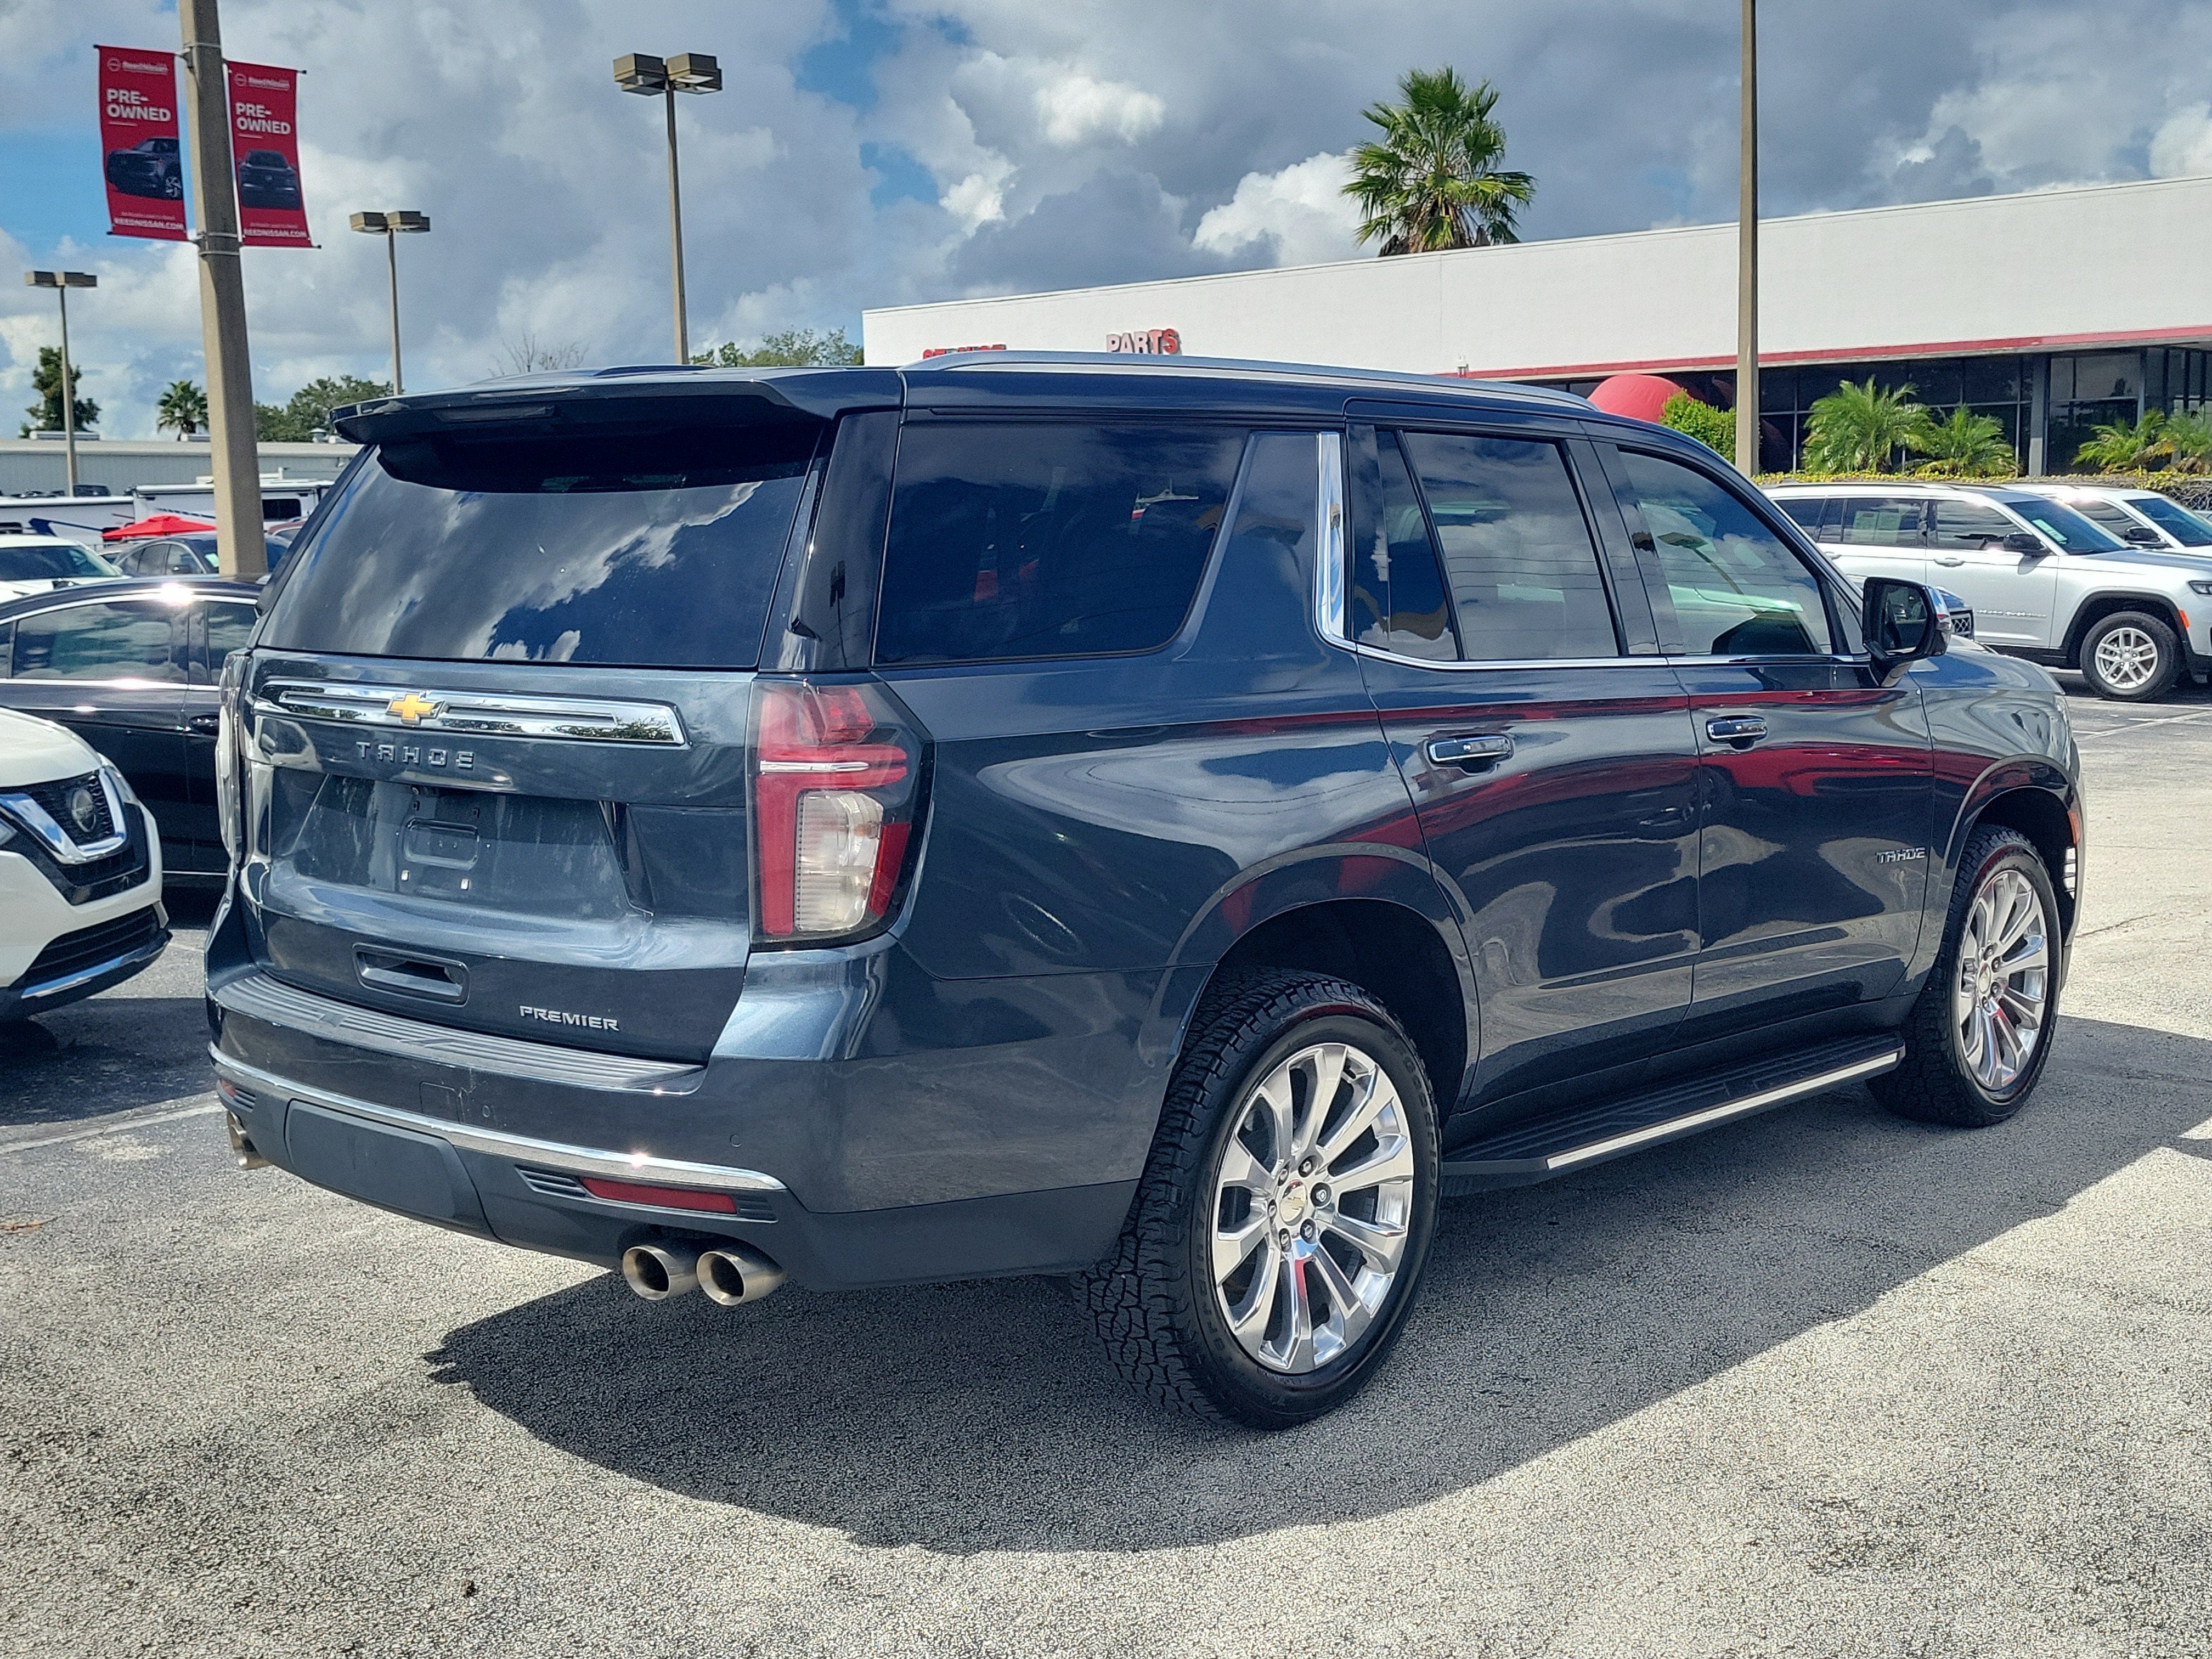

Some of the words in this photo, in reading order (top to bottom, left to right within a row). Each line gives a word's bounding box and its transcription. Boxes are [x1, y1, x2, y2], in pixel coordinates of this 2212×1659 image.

[106, 88, 150, 104] PRE-
[106, 103, 171, 122] OWNED
[235, 102, 272, 118] PRE-
[236, 116, 291, 135] OWNED
[1106, 329, 1179, 355] PARTS
[356, 741, 475, 768] TAHOE
[1876, 847, 1926, 864] TAHOE
[519, 1005, 620, 1031] PREMIER
